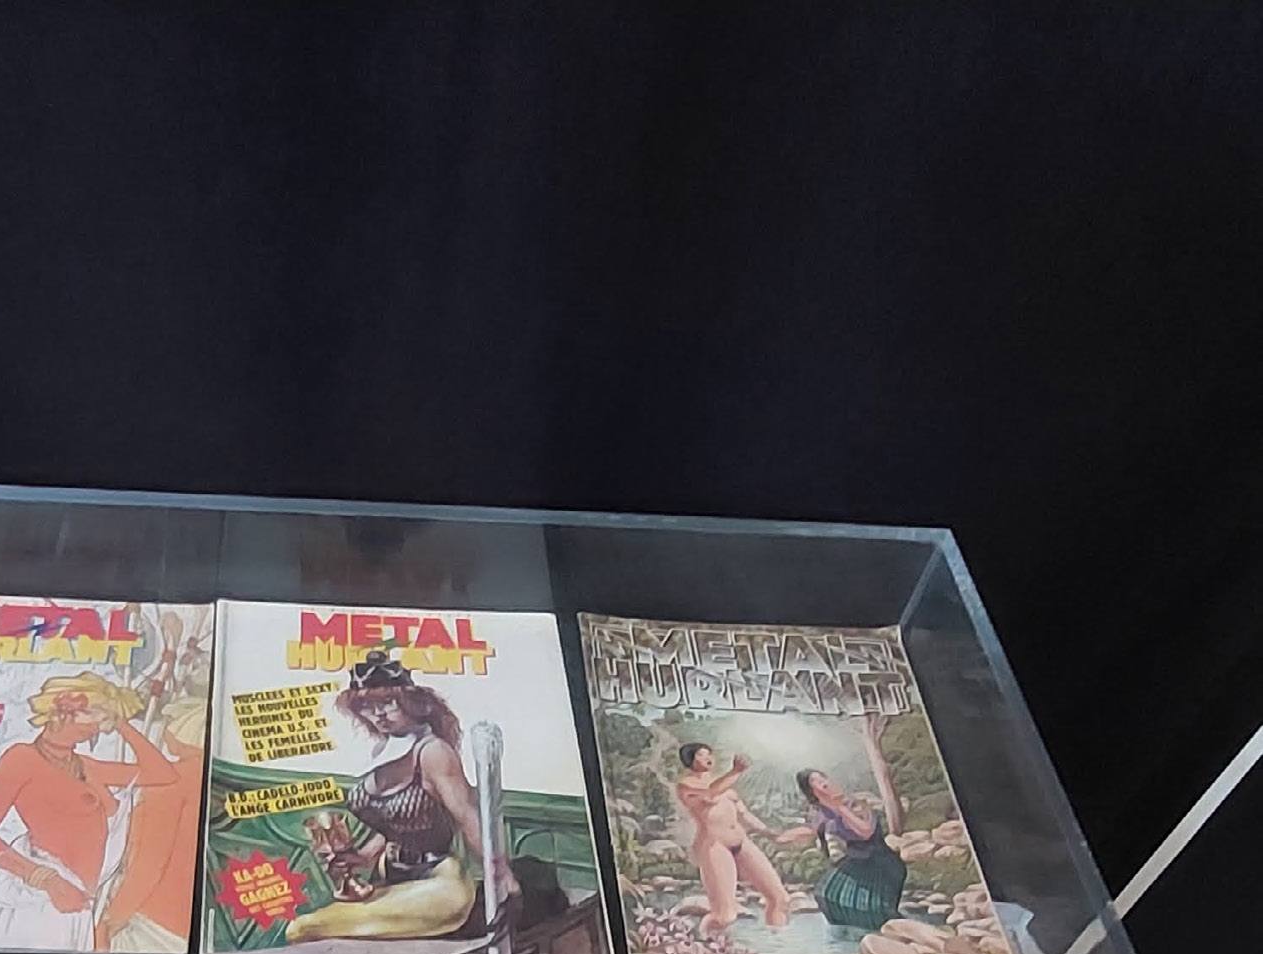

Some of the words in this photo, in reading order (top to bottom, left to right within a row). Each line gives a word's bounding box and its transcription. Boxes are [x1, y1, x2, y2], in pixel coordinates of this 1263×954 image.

[300, 611, 487, 649] METAL
[289, 688, 301, 698] ET
[305, 683, 332, 695] SEXY
[590, 657, 911, 716] HURLANT
[235, 705, 254, 715] LES
[258, 697, 318, 713] NOUVELLES
[238, 712, 293, 727] HEROINES
[298, 708, 314, 720] DU
[242, 725, 284, 738] CINEMA
[314, 718, 328, 728] ET
[245, 740, 265, 751] LES
[268, 731, 321, 748] FEMELLES
[248, 753, 264, 763] DE
[275, 790, 342, 811] CARNIVORE
[239, 880, 291, 905] GAGNEZ
